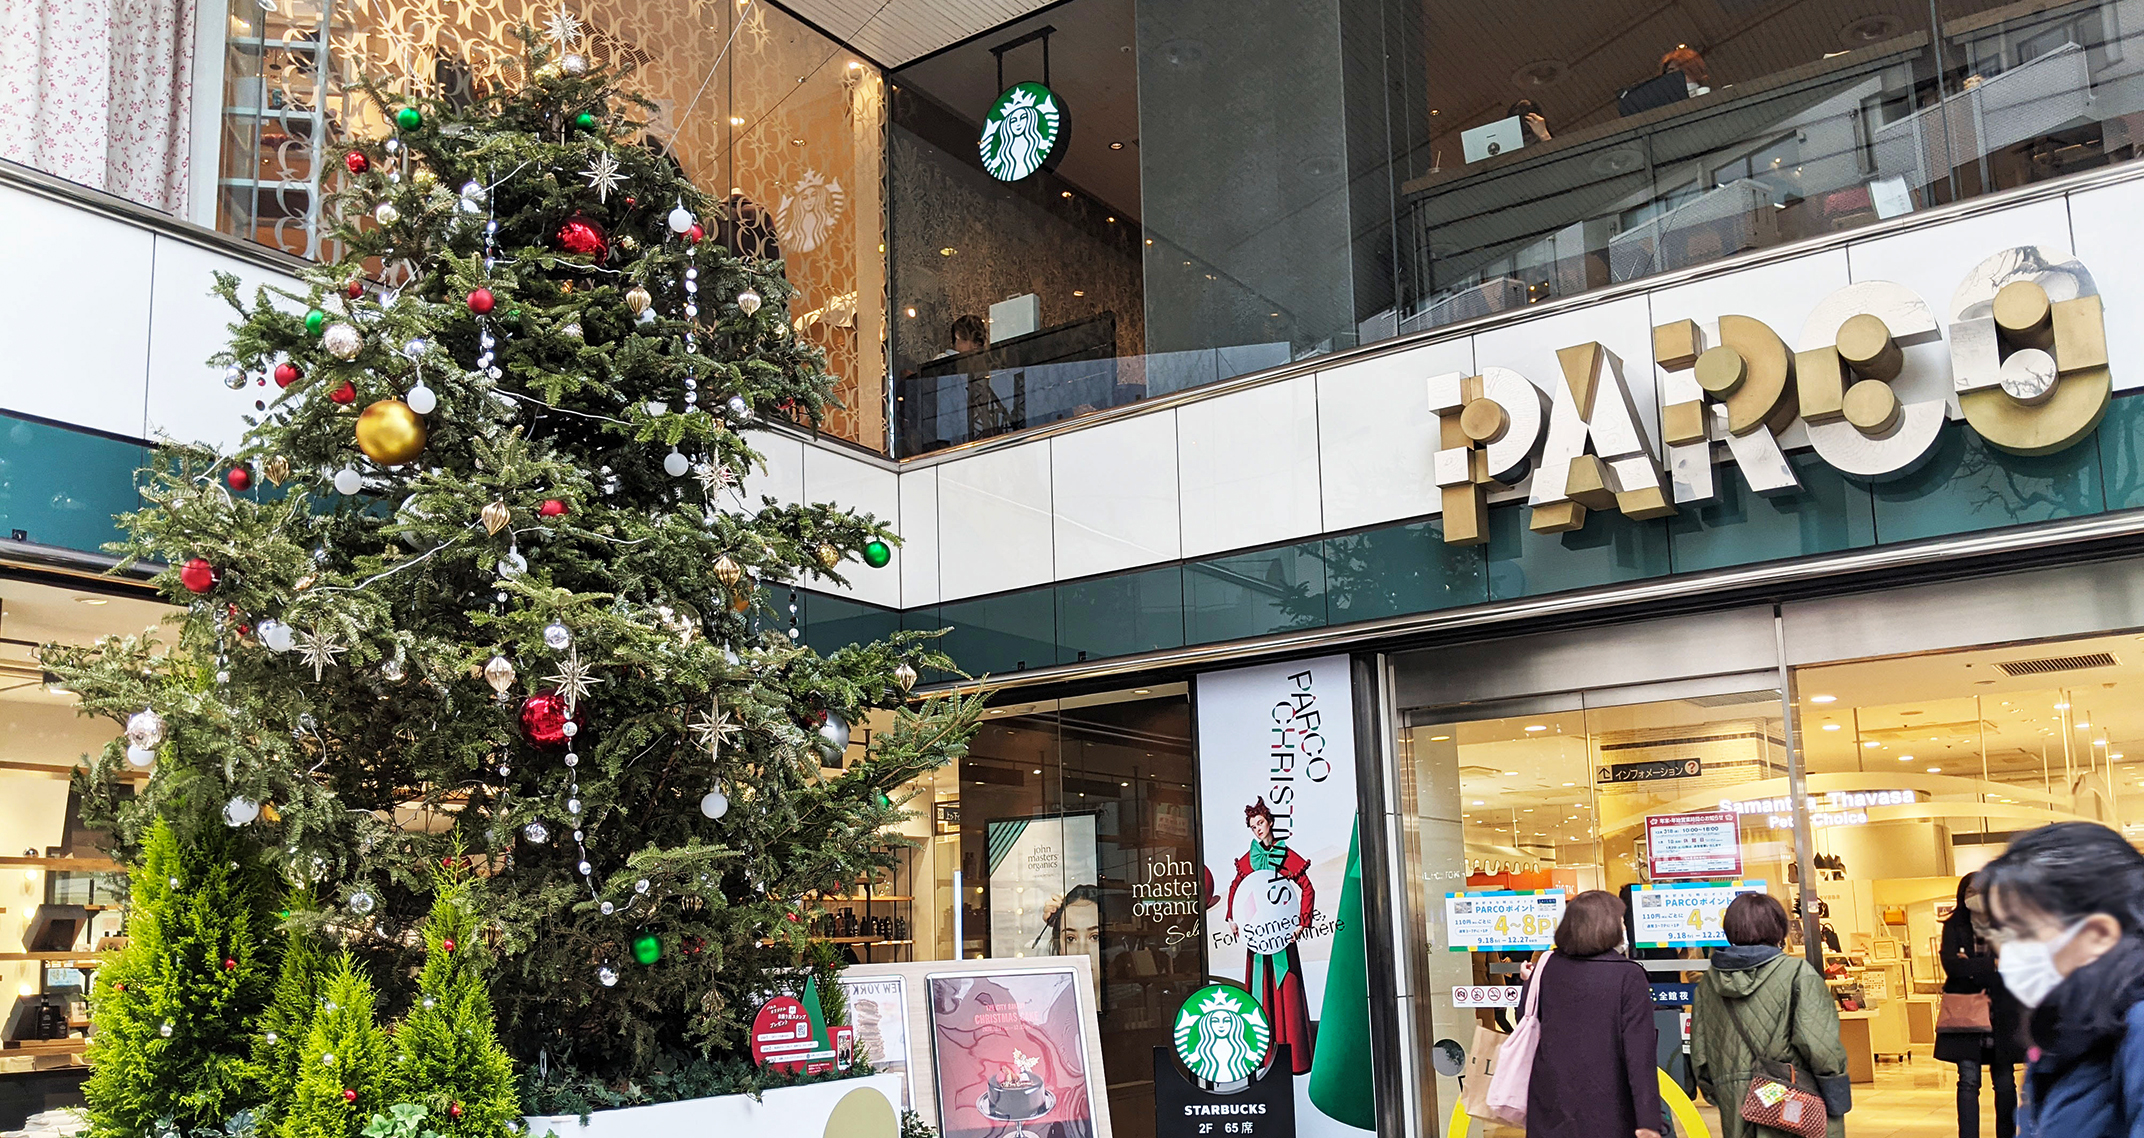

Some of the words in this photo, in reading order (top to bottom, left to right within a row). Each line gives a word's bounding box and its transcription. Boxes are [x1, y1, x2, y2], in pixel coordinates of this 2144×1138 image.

[1428, 245, 2112, 546] PARCO
[1287, 670, 1331, 782] PARCO
[1615, 766, 1683, 780] インフォメーション
[1267, 701, 1297, 906] CHRISTMAS
[1718, 797, 1818, 815] Samanta
[1827, 789, 1916, 809] Thavasa
[1812, 811, 1868, 826] Choice
[1033, 844, 1052, 856] john
[1027, 854, 1058, 862] masters
[1027, 861, 1058, 871] organics
[1148, 854, 1194, 884] john
[1475, 904, 1535, 914] PARCOポイント
[1212, 931, 1238, 949] For
[1247, 918, 1346, 953] Somewhere
[974, 1012, 1018, 1025] CHRISTMAS
[1184, 1103, 1267, 1116] STARBUCKS
[1198, 1123, 1213, 1134] 2F
